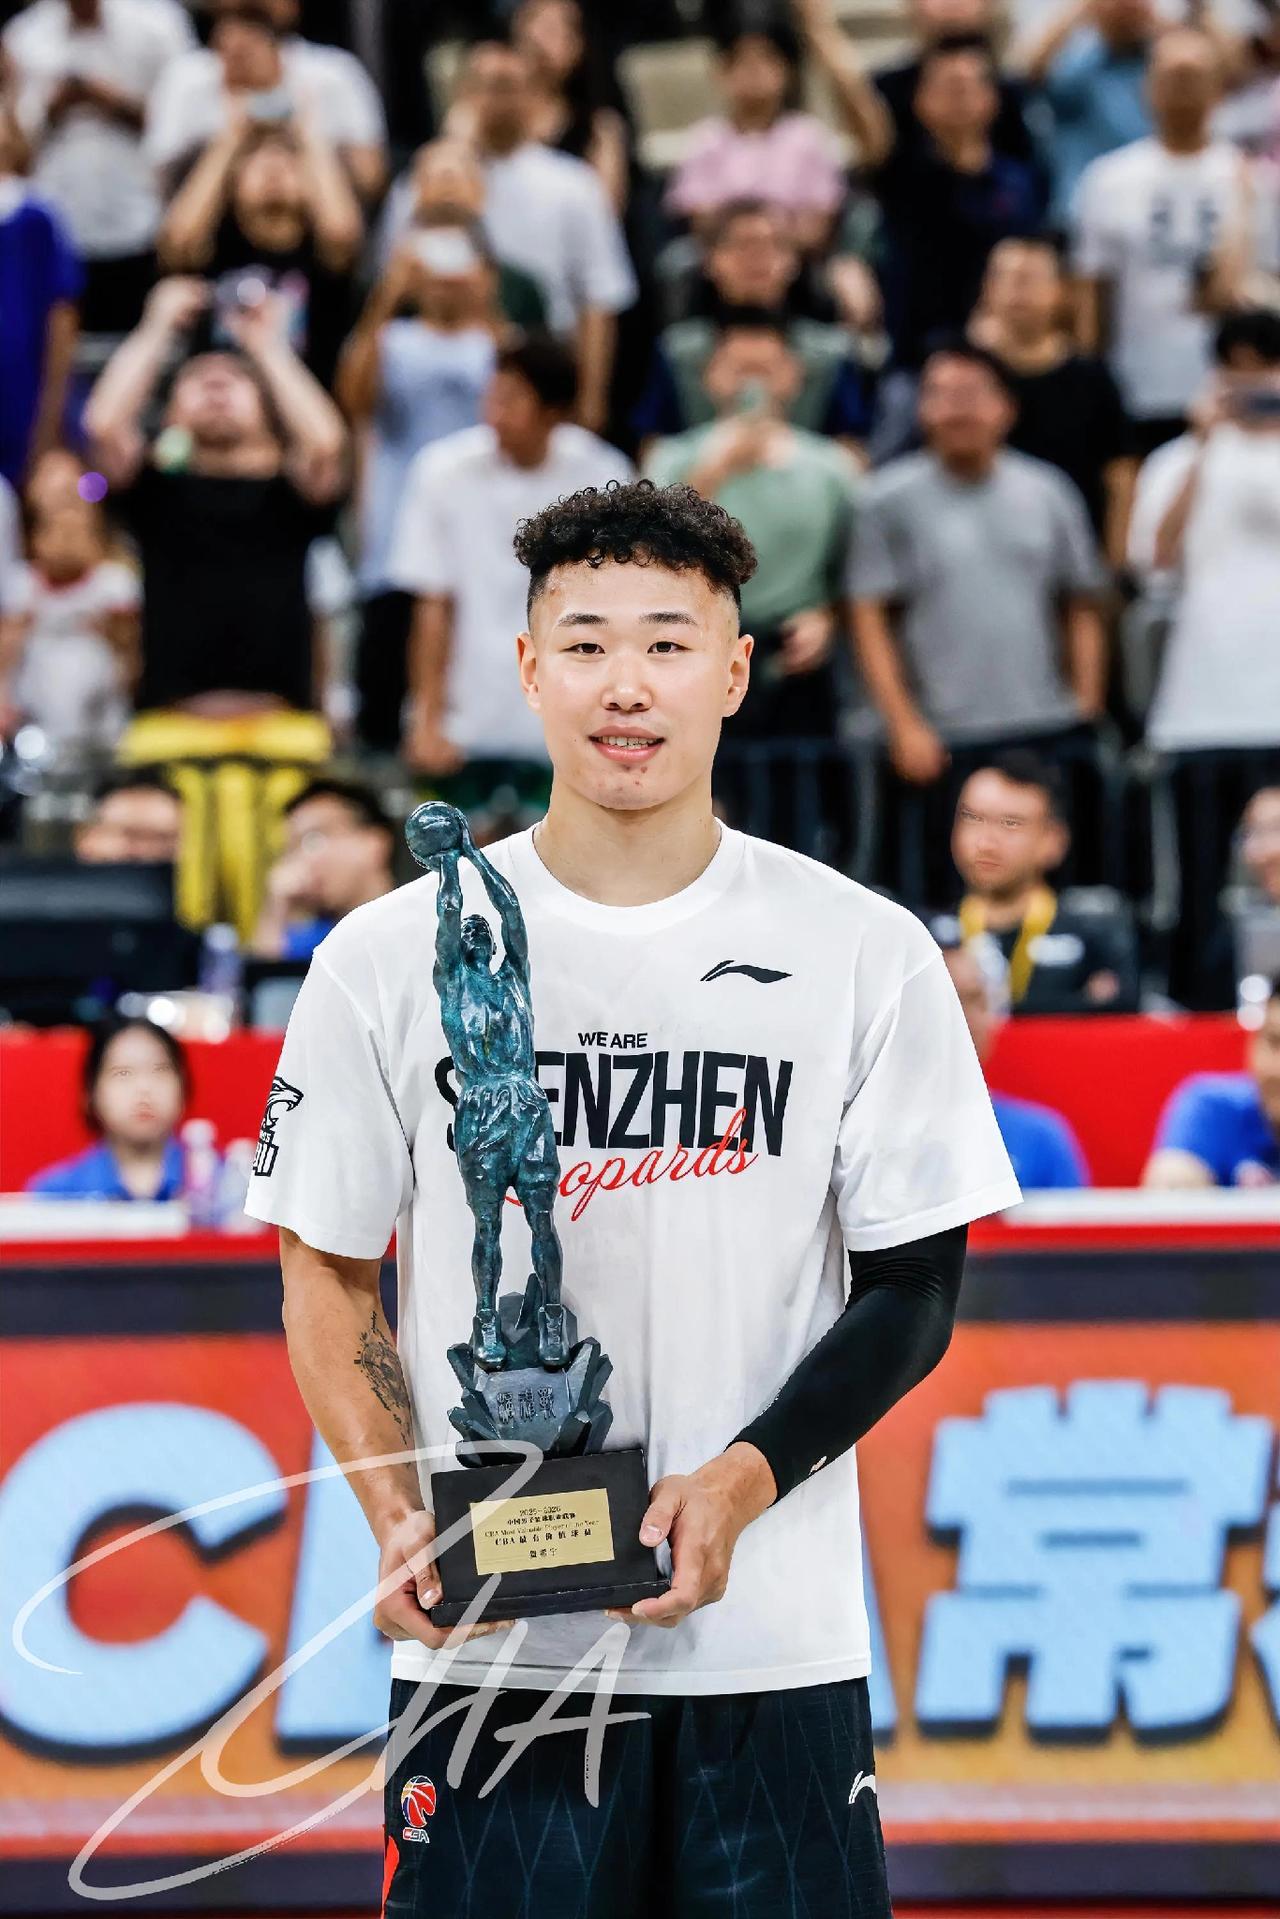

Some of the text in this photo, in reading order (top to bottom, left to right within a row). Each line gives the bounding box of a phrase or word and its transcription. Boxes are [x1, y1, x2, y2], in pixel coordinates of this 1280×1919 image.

[578, 1032, 648, 1048] WE ARE
[434, 1050, 794, 1157] ENZHEN
[403, 1826, 430, 1843] CBA
